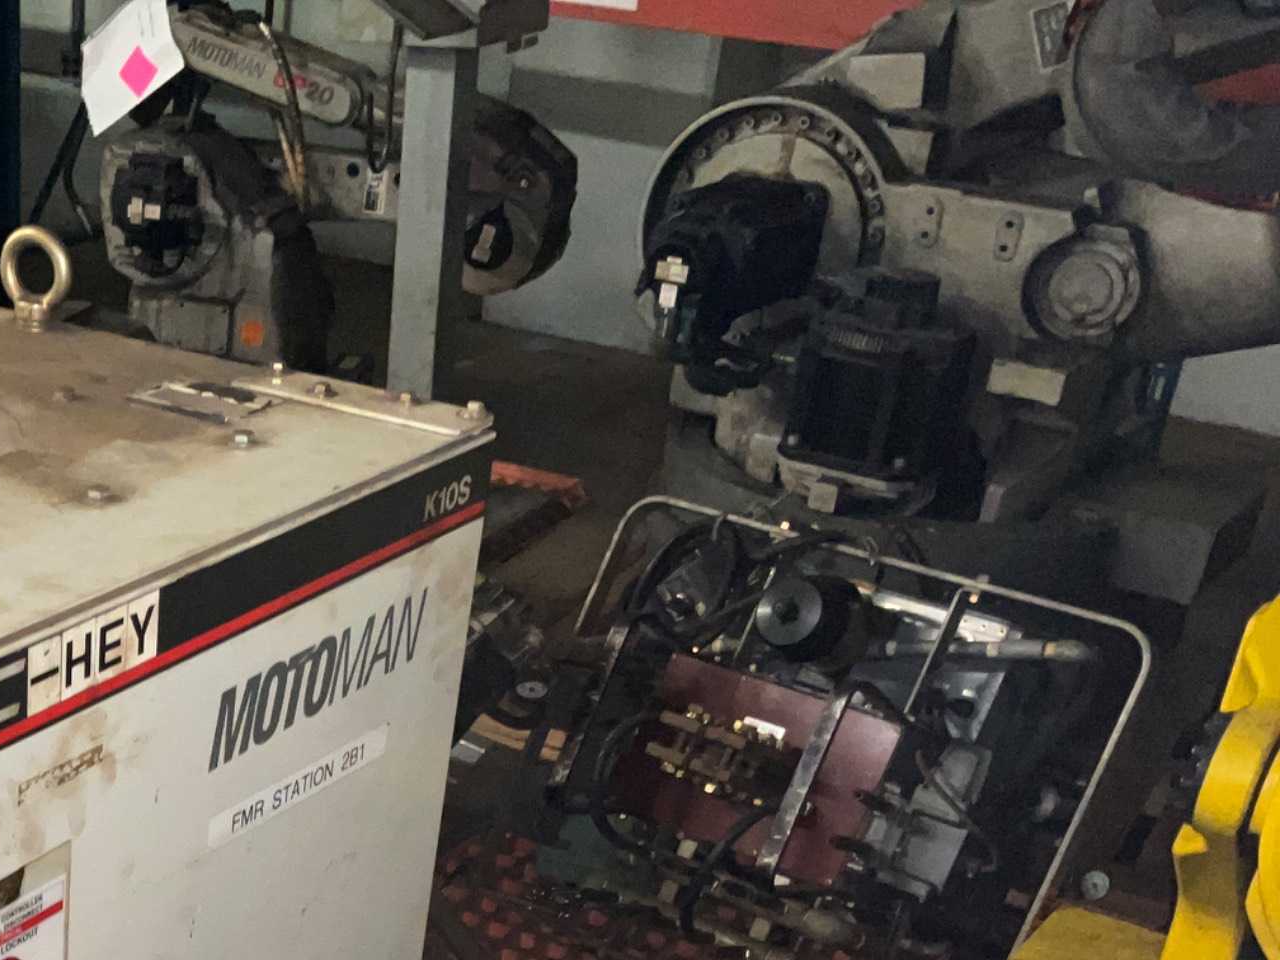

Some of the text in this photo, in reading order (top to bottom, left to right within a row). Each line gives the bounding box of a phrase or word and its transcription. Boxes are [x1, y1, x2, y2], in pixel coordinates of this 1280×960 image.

[187, 36, 266, 79] MOTOMAN
[423, 474, 472, 521] K10S
[208, 587, 428, 773] MOTOMAN
[232, 744, 365, 833] FMR STATION 2B1
[0, 927, 38, 954] LOCKOUT
